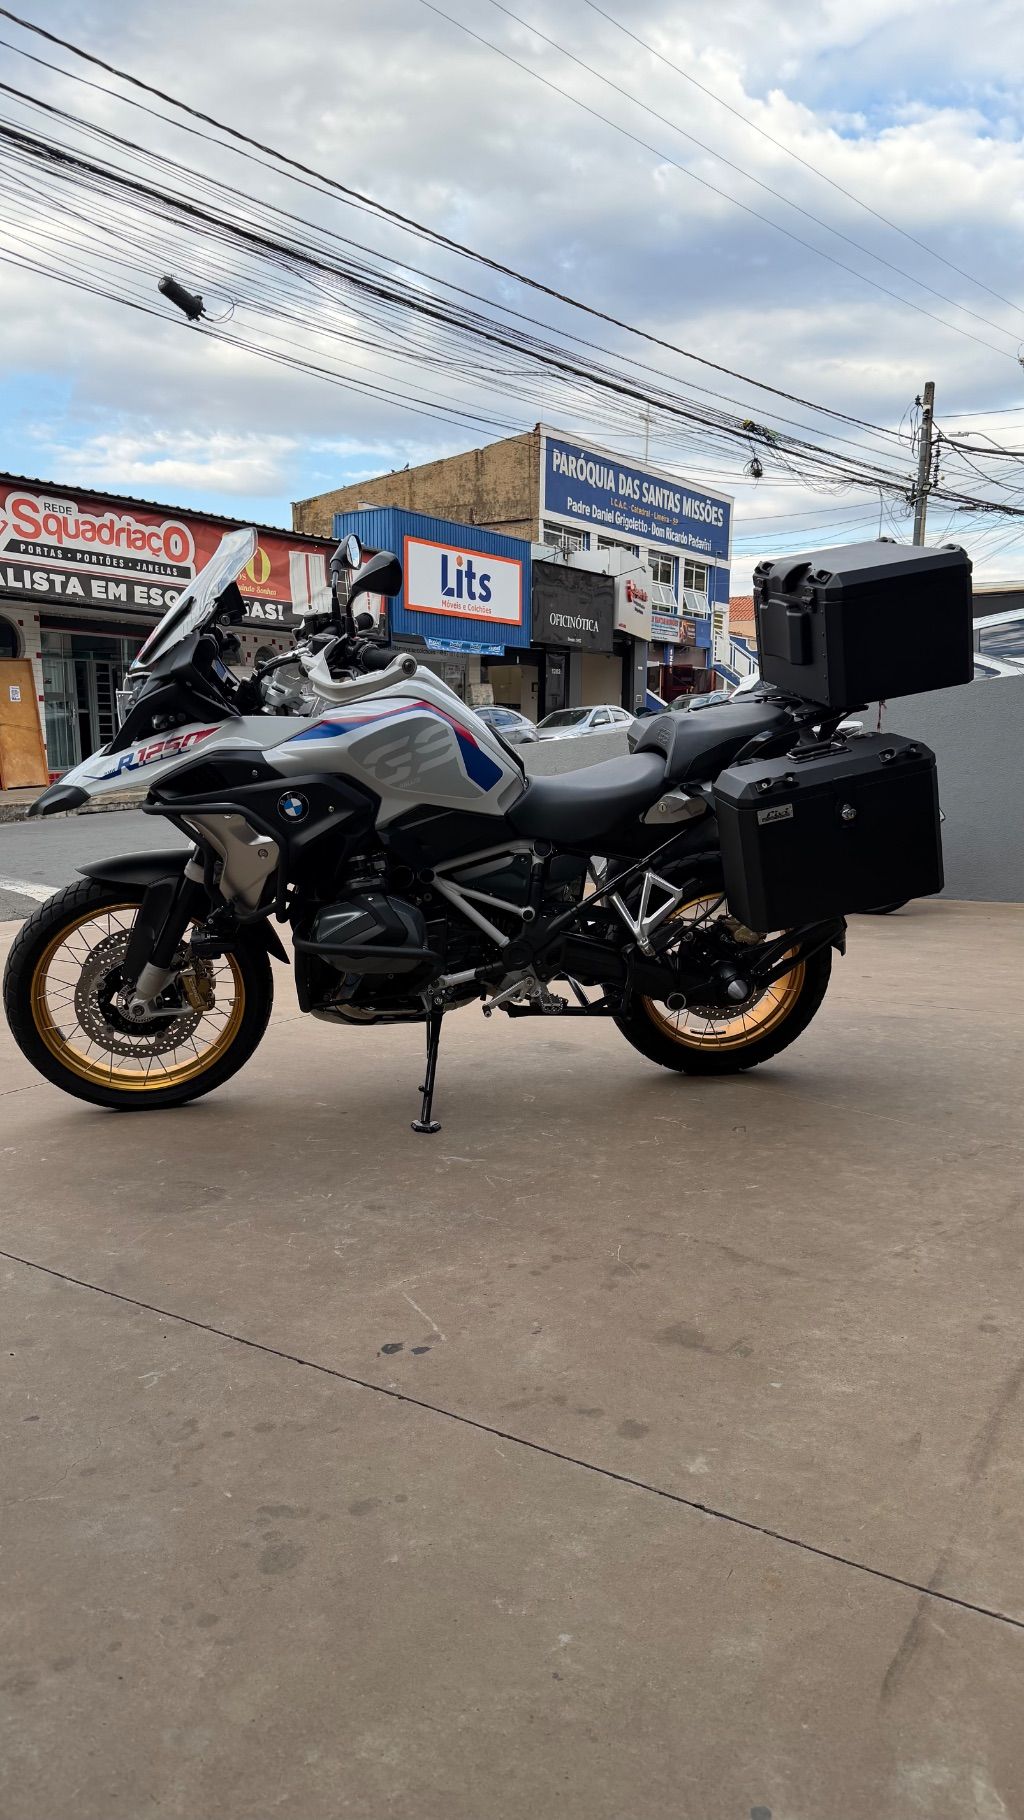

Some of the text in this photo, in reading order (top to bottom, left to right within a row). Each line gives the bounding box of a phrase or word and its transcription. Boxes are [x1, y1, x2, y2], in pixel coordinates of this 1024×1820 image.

[553, 448, 723, 527] PARÓQUIA DAS SANTAS MISSÕES
[43, 502, 73, 516] REDE
[567, 496, 591, 516] Padre
[592, 504, 615, 523] Daniel
[615, 511, 648, 533] Grigoletto
[651, 522, 665, 538] Dom
[665, 527, 688, 545] Ricardo
[20, 543, 178, 576] PORTAS PORTÕES JANELAS
[90, 579, 127, 602] EM
[441, 553, 492, 603] Lits
[441, 599, 462, 610] Móveis
[467, 603, 492, 614] Colchões
[549, 612, 599, 633] OFICINÓTICA
